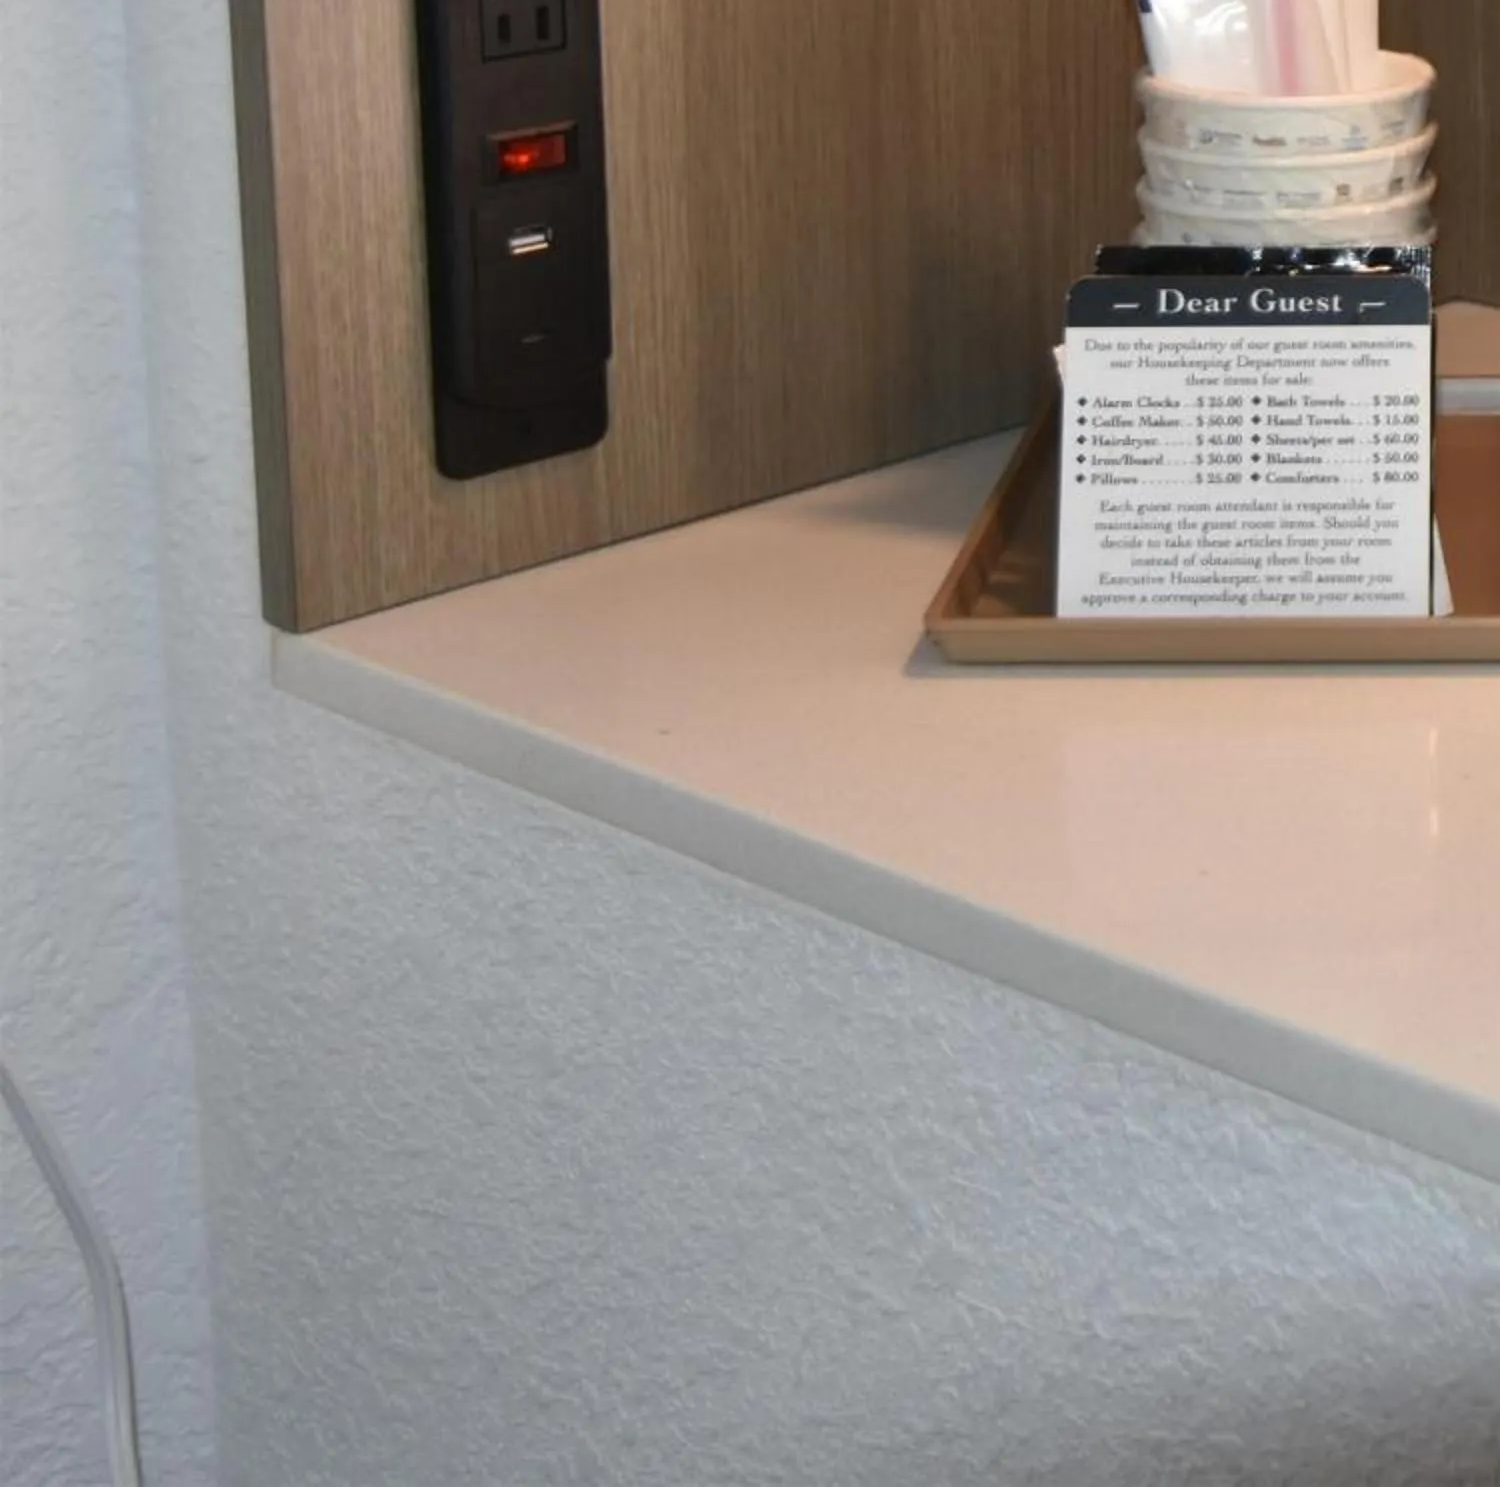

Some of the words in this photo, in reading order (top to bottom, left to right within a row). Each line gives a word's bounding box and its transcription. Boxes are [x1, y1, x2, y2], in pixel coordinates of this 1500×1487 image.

[1157, 288, 1238, 313] Dear
[1250, 288, 1343, 313] Guest
[1084, 338, 1112, 351] Due
[1117, 340, 1131, 351] to
[1134, 338, 1152, 351] the
[1158, 338, 1227, 354] popularity
[1230, 337, 1245, 350] of
[1248, 340, 1270, 350] our
[1273, 340, 1308, 353] guest
[1312, 340, 1348, 350] room
[1110, 358, 1132, 369] our
[1137, 356, 1232, 371] Housekeeping
[1236, 354, 1316, 371] Department
[1319, 358, 1348, 367] now
[1351, 355, 1391, 367] offers
[1186, 374, 1220, 386] these
[1223, 374, 1258, 386] items
[1262, 373, 1282, 385] for
[1100, 499, 1134, 513] Each
[1136, 502, 1171, 515] guest
[1177, 503, 1211, 512] room
[1215, 498, 1278, 512] attendant
[1282, 499, 1292, 510] is
[1297, 498, 1371, 513] responsible
[1375, 497, 1396, 510] for
[1094, 520, 1173, 534] maintaining
[1177, 517, 1197, 530] the
[1202, 520, 1238, 533] guest
[1241, 520, 1275, 529] room
[1323, 516, 1371, 529] Should
[1373, 519, 1400, 532] you
[1099, 535, 1143, 548] decide
[1147, 537, 1161, 548] to
[1165, 535, 1192, 548] take
[1197, 535, 1232, 548] these
[1235, 535, 1283, 547] articles
[1287, 534, 1319, 547] from
[1322, 538, 1354, 550] your
[1358, 537, 1393, 547] room
[1131, 553, 1179, 566] instead
[1183, 552, 1197, 566] of
[1202, 552, 1262, 569] obtaining
[1267, 552, 1300, 565] them
[1304, 552, 1336, 565] from
[1340, 552, 1360, 564] the
[1099, 571, 1166, 585] Executive
[1266, 574, 1284, 584] we
[1289, 571, 1314, 583] will
[1317, 574, 1364, 583] assume
[1368, 574, 1393, 586] you
[1081, 594, 1136, 608] approve
[1152, 589, 1247, 606] corresponding
[1251, 588, 1297, 605] charge
[1301, 591, 1315, 602] to
[1317, 592, 1349, 605] your
